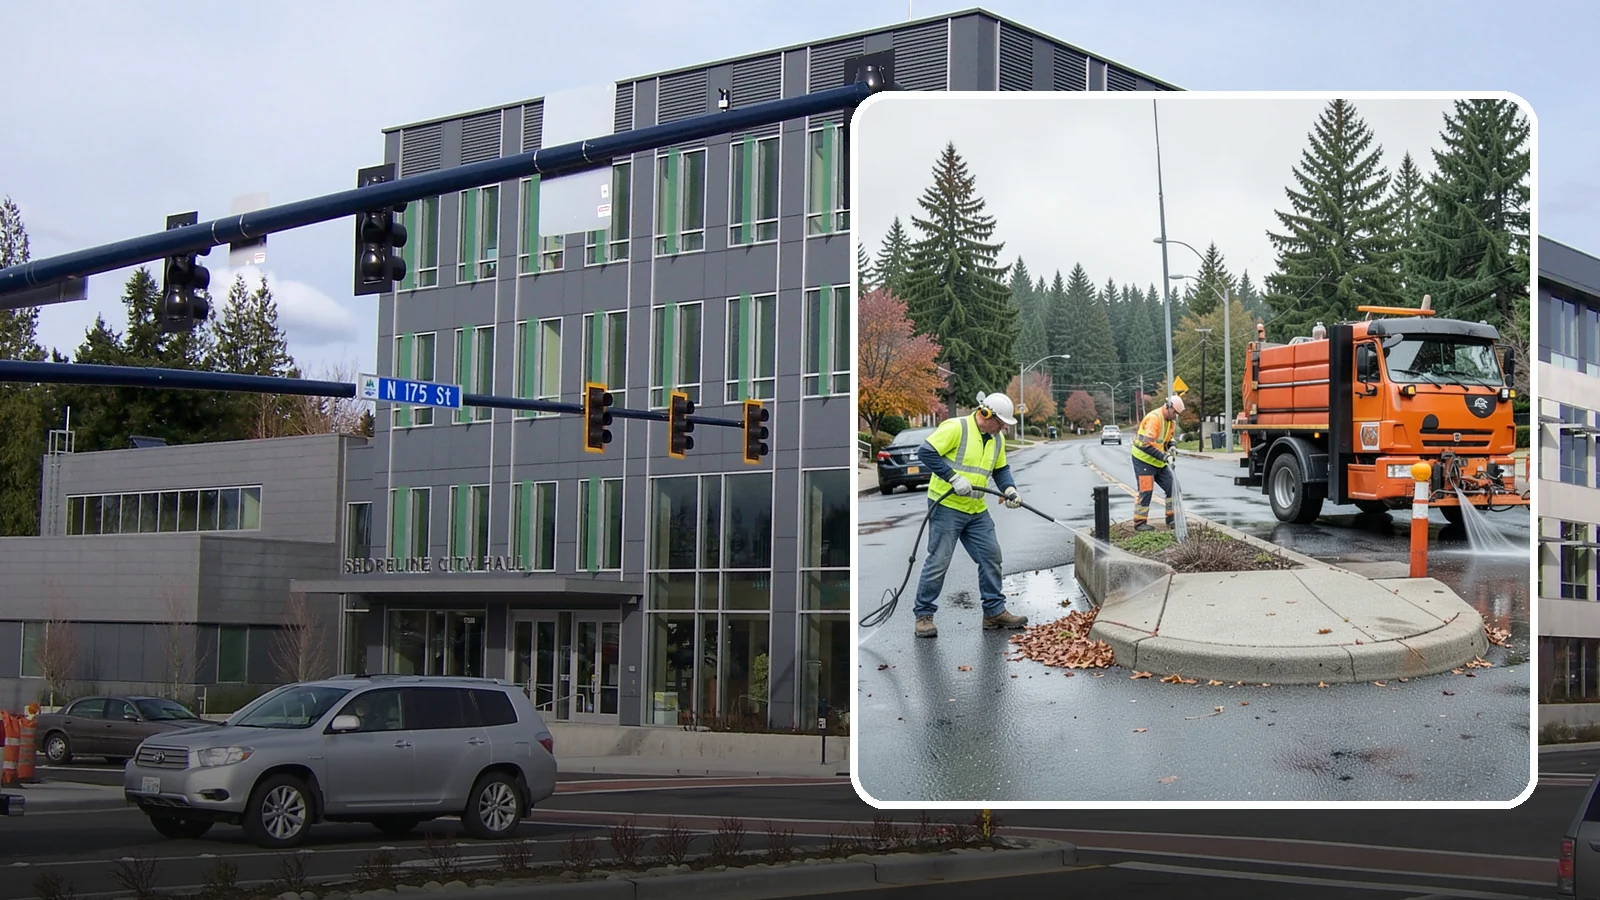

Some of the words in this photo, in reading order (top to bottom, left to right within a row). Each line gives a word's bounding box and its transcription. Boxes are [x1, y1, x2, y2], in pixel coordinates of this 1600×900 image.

[387, 380, 396, 400] N
[405, 382, 428, 403] 175
[436, 386, 452, 406] St
[344, 557, 432, 574] SHORELINE
[438, 557, 474, 572] CITY
[483, 556, 525, 571] HALL
